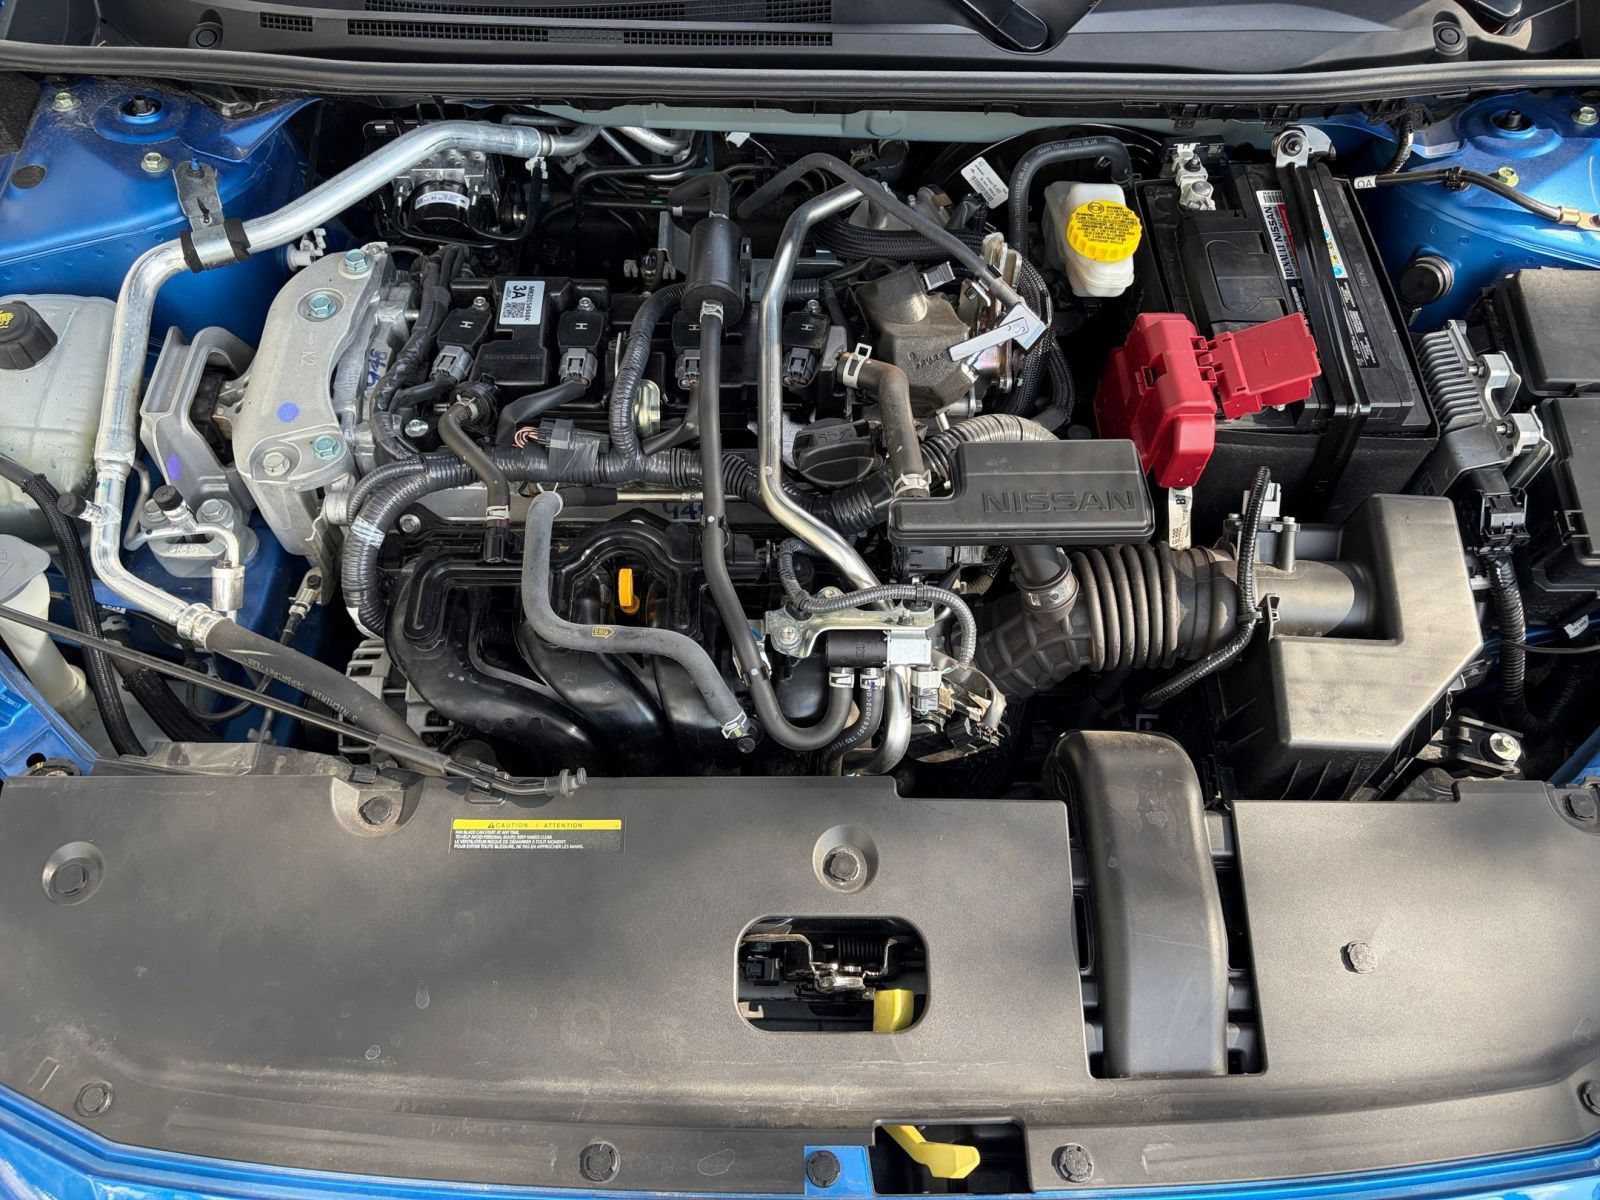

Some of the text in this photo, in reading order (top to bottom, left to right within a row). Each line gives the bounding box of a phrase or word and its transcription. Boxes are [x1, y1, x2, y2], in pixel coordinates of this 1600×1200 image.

[1264, 206, 1282, 243] NISSAN
[1277, 244, 1294, 277] RENAULT
[512, 285, 527, 299] 3A
[302, 351, 316, 366] K2
[981, 489, 1136, 513] NISSAN
